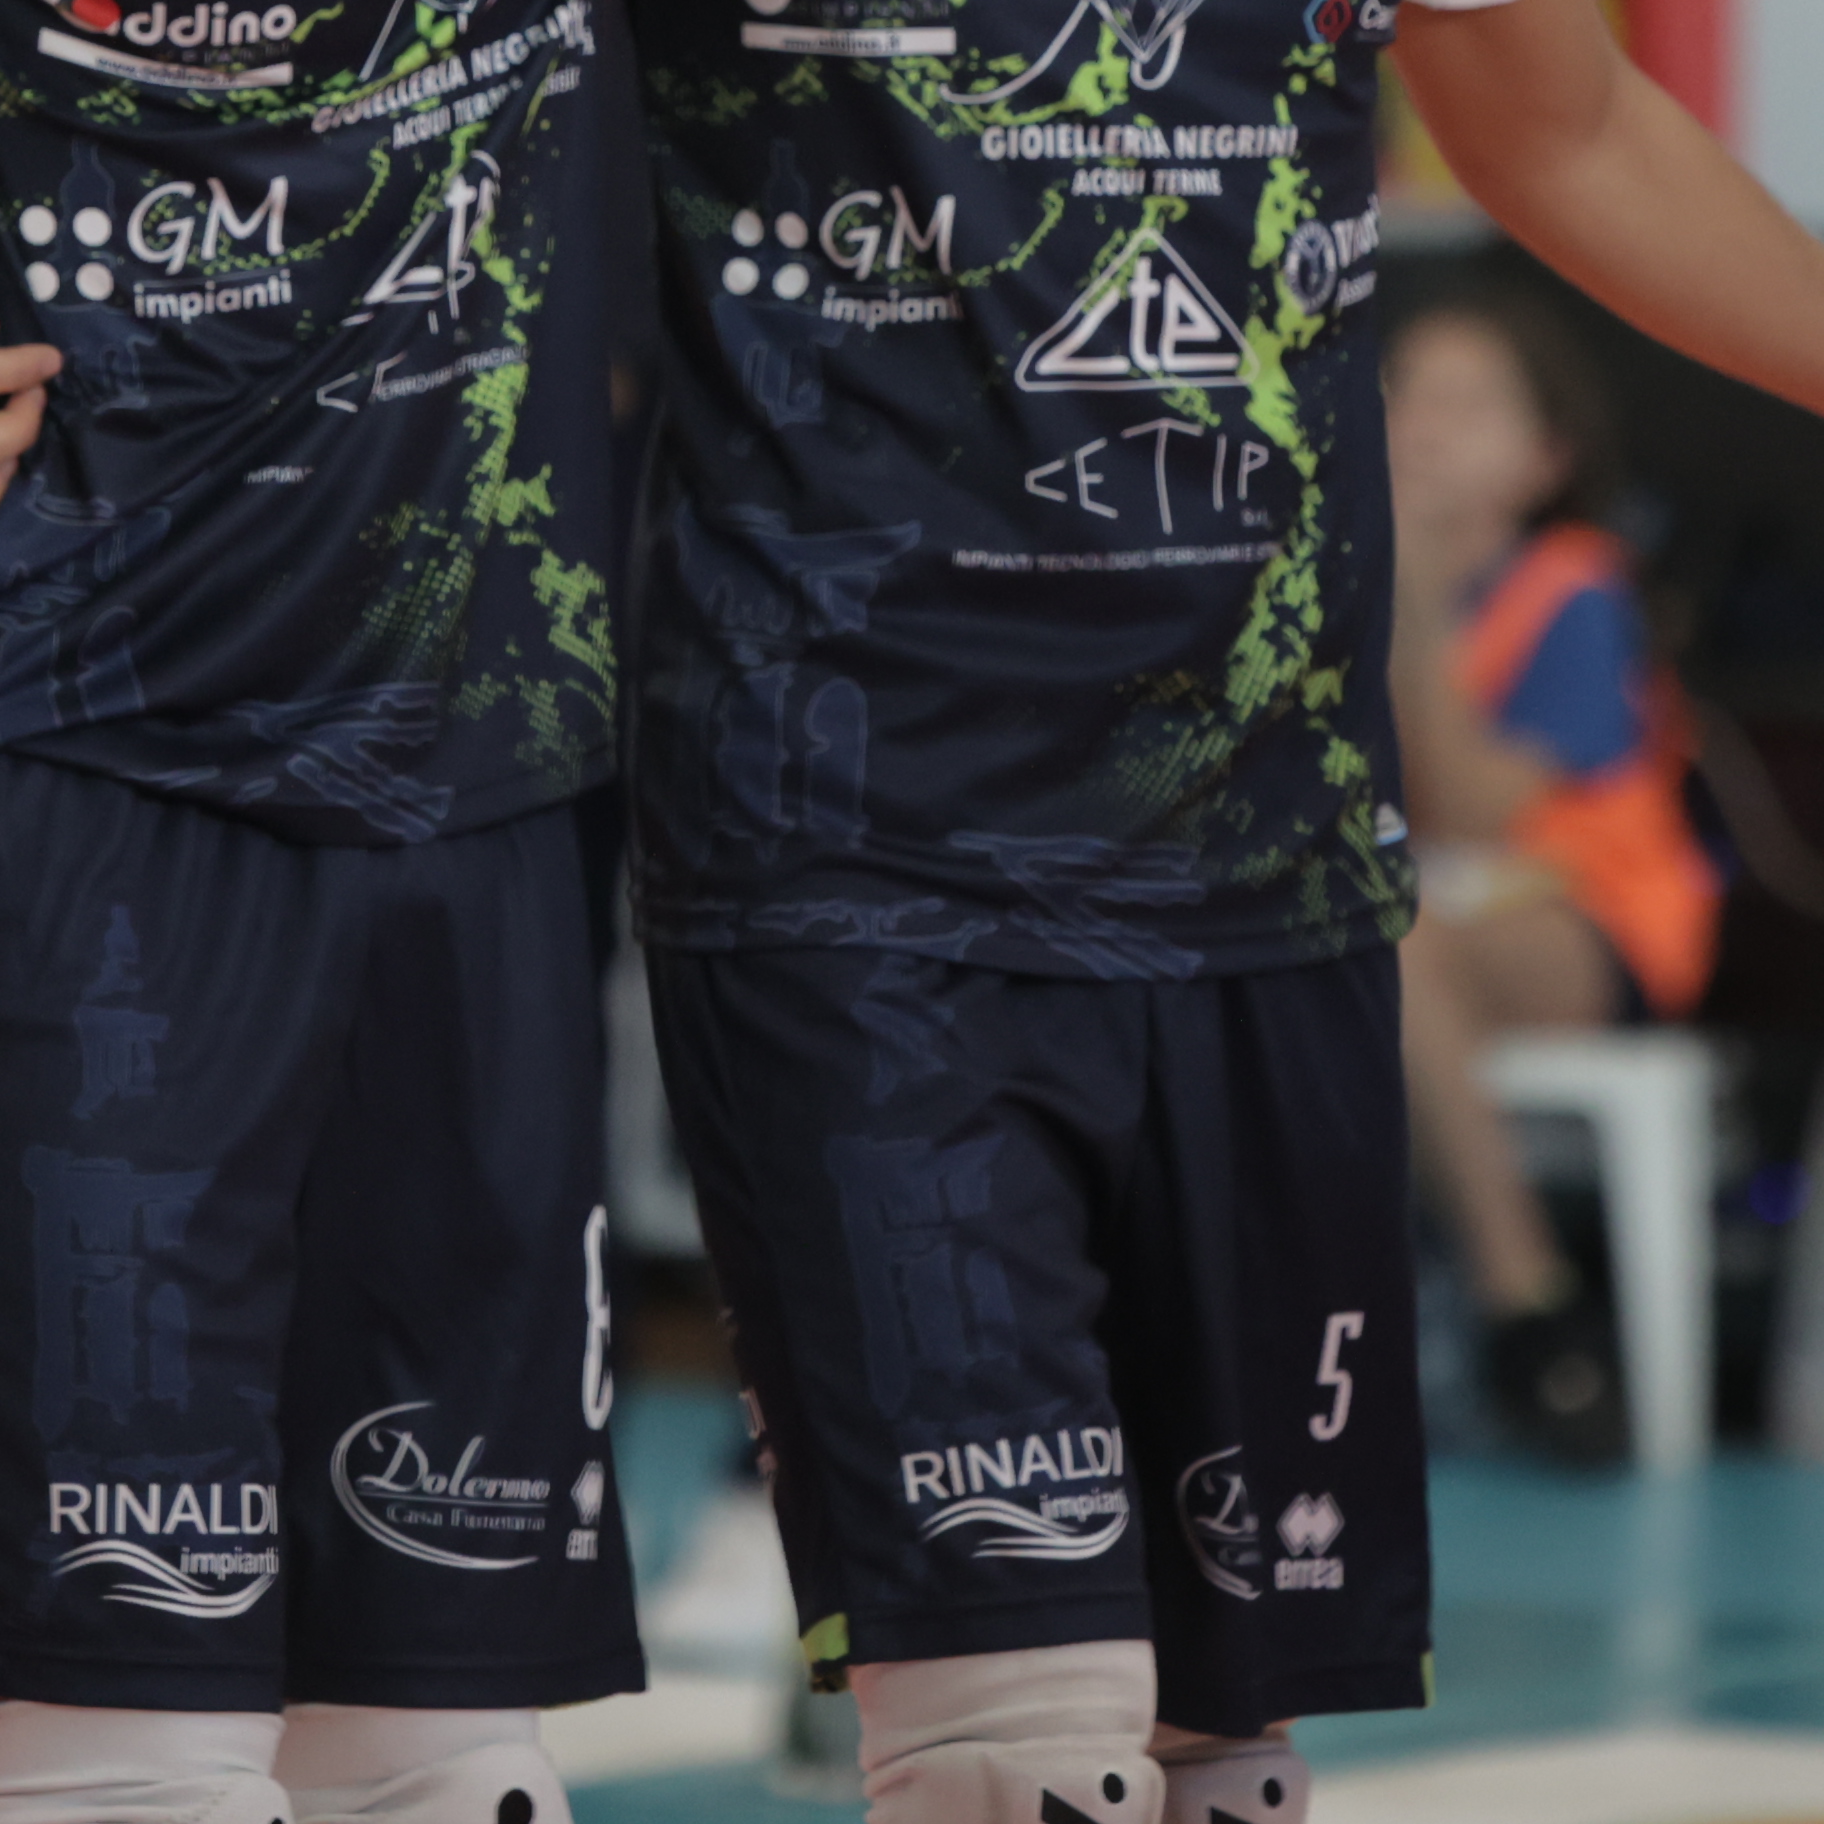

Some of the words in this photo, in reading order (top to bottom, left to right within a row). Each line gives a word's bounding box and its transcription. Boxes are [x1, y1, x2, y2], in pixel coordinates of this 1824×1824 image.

[981, 124, 1171, 161] GIOIELLERIA
[1173, 124, 1298, 161] NEGRINI
[1071, 168, 1145, 197] ACQUI
[126, 175, 289, 276] GM
[819, 184, 956, 281] GM
[133, 268, 292, 324] impianti
[1308, 1310, 1365, 1442] 5
[900, 1426, 1124, 1504] RINALDI
[49, 1482, 279, 1536] RINALDI
